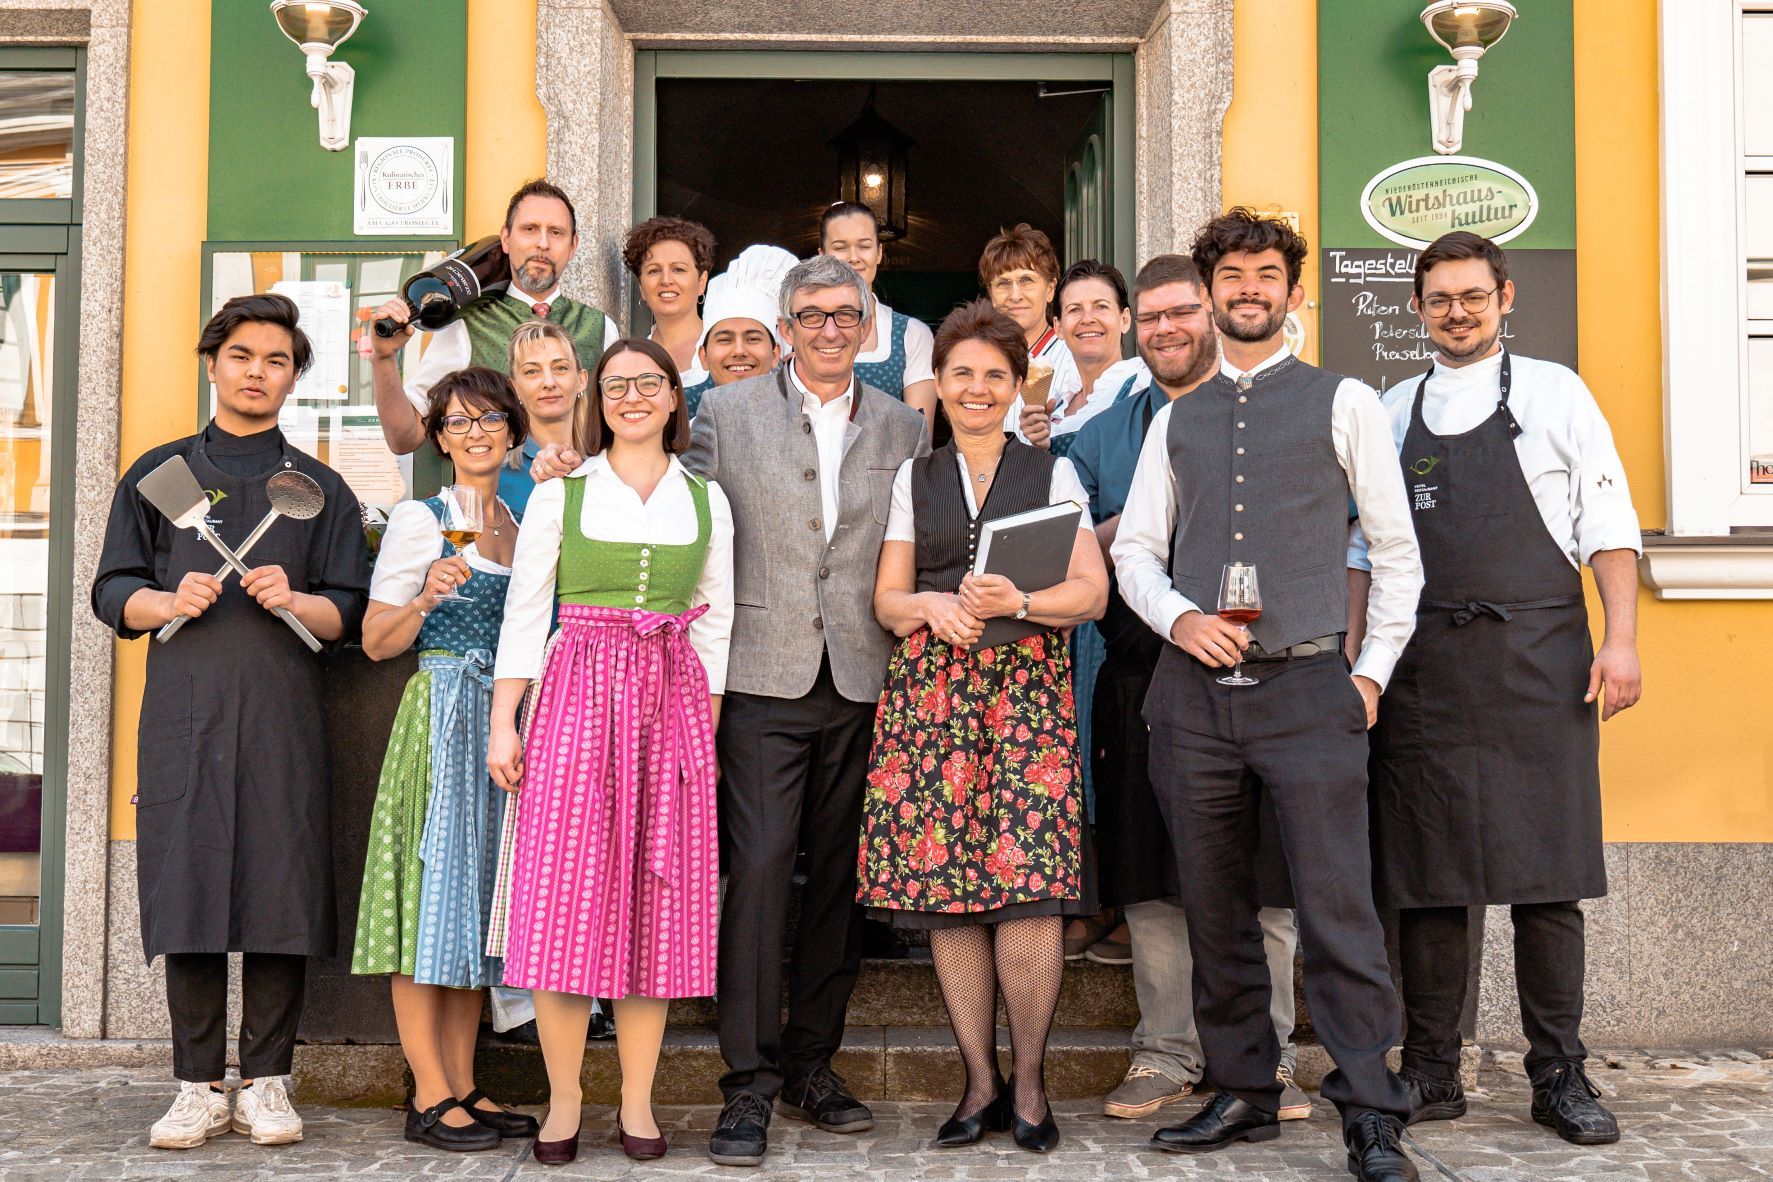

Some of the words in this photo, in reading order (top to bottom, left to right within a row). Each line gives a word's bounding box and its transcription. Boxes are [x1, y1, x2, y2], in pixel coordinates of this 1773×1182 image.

[388, 181, 419, 190] ERBE
[1385, 174, 1478, 195] NIEDERÖSTERREICHISCHE
[1382, 186, 1502, 217] Wirtshaus-
[1411, 214, 1427, 224] SEIT
[1451, 203, 1518, 228] kultur
[1329, 251, 1417, 284] Tagestell
[1352, 291, 1399, 317] Puten
[1370, 321, 1429, 340] Petersili
[1372, 342, 1440, 361] Preiselbe
[1414, 493, 1431, 502] ZUR
[1414, 500, 1437, 510] POST
